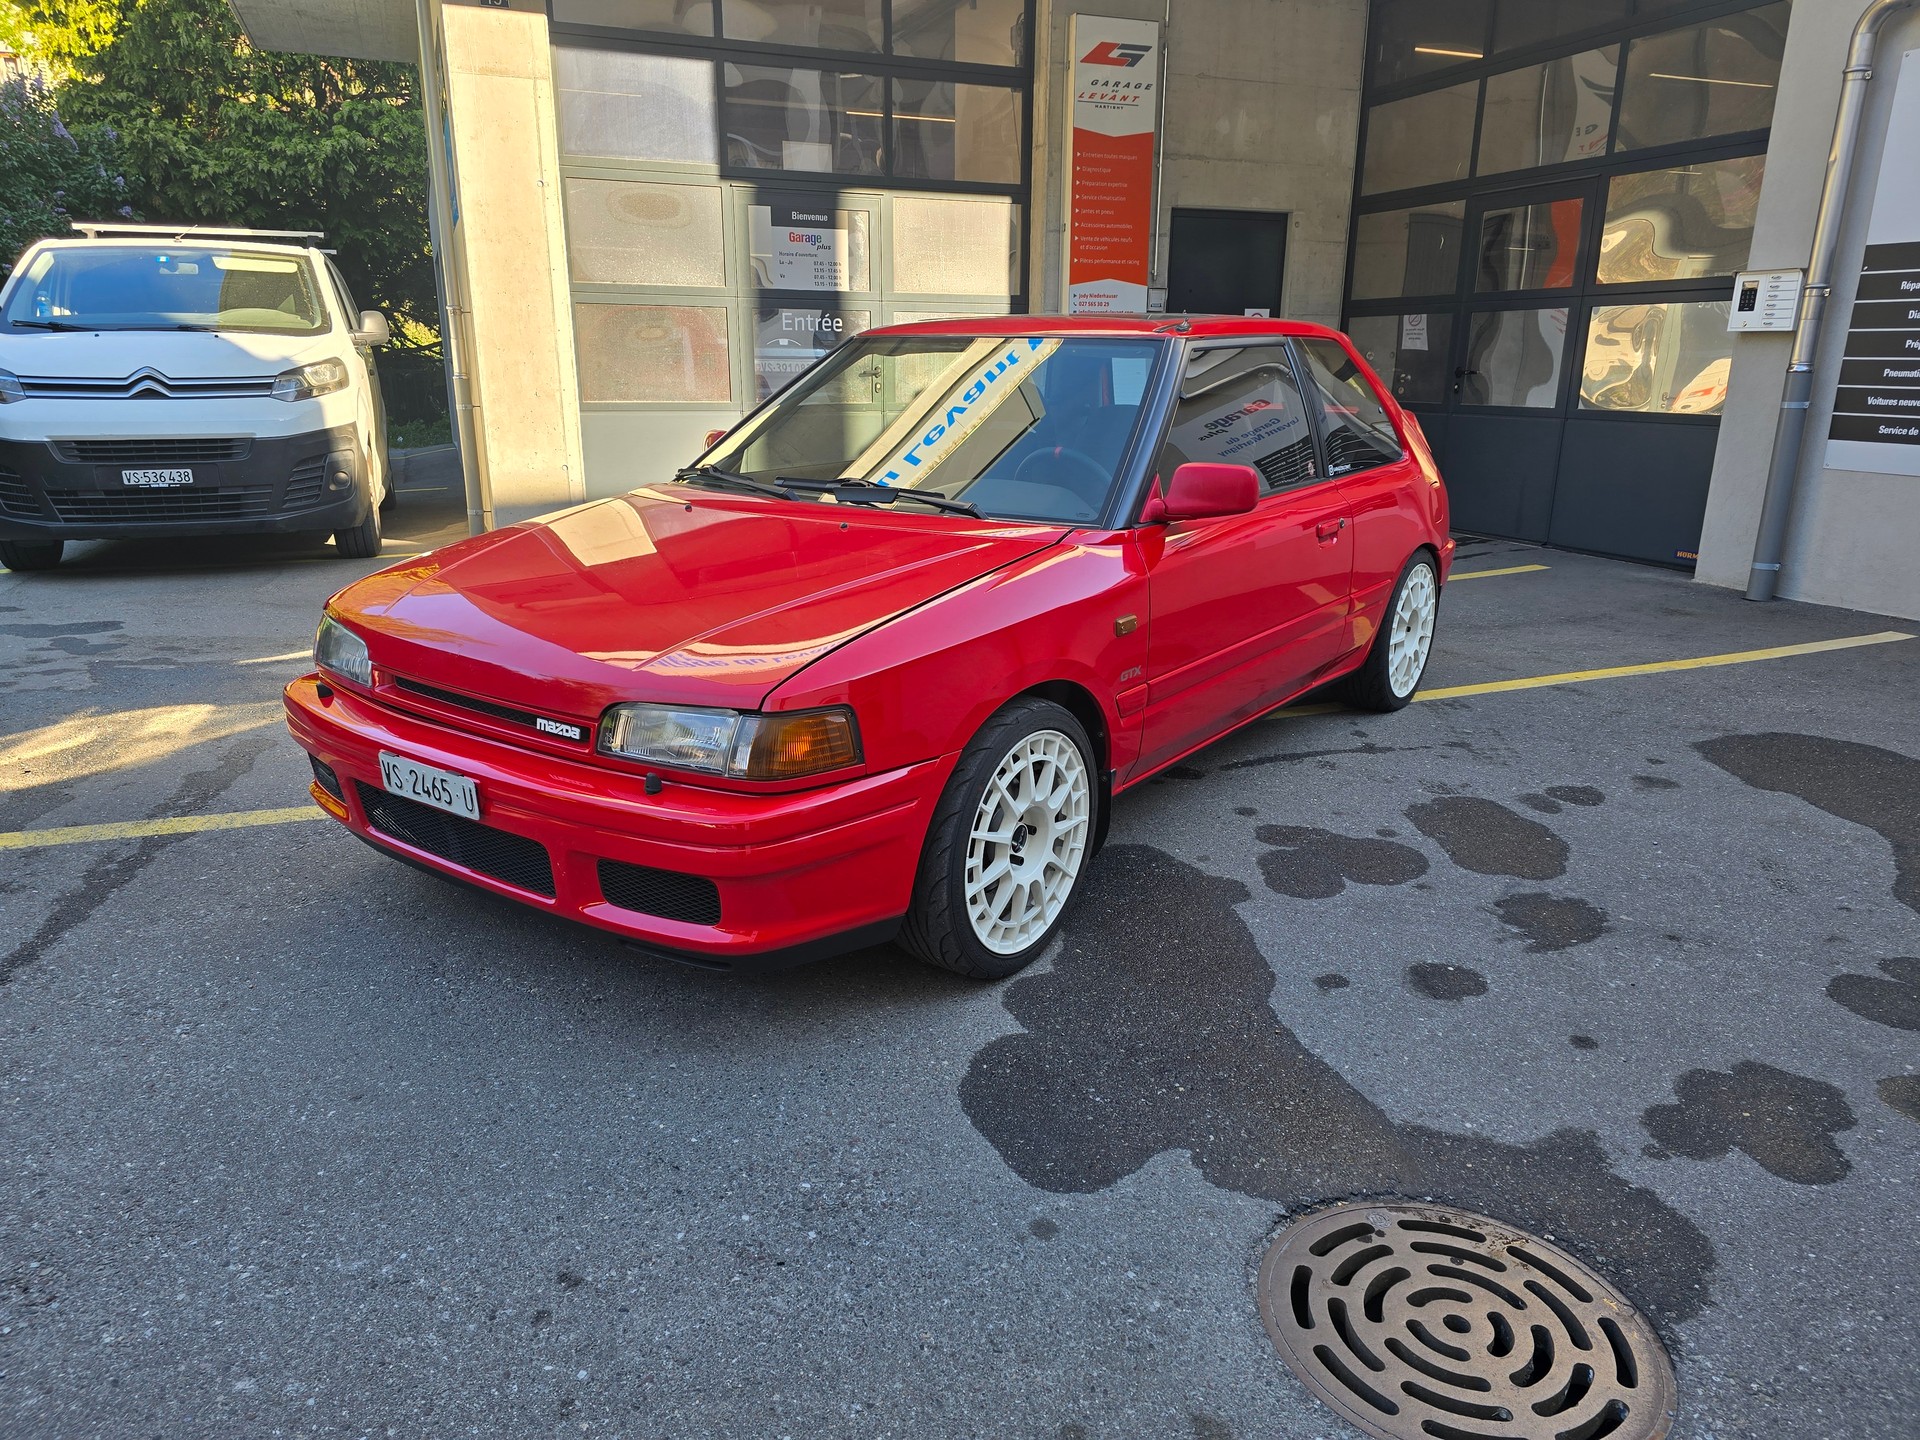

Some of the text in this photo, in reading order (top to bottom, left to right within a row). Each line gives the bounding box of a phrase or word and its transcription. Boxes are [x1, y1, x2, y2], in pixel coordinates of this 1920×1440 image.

[1090, 79, 1153, 90] GARAGE
[1078, 91, 1140, 102] LEVANT
[791, 211, 828, 222] Bienvenue
[789, 231, 822, 246] Garage
[781, 313, 843, 332] Entrée
[1867, 396, 1898, 405] Voitures
[1879, 425, 1919, 436] Service de
[1120, 665, 1142, 682] GTX
[536, 717, 581, 740] mazda
